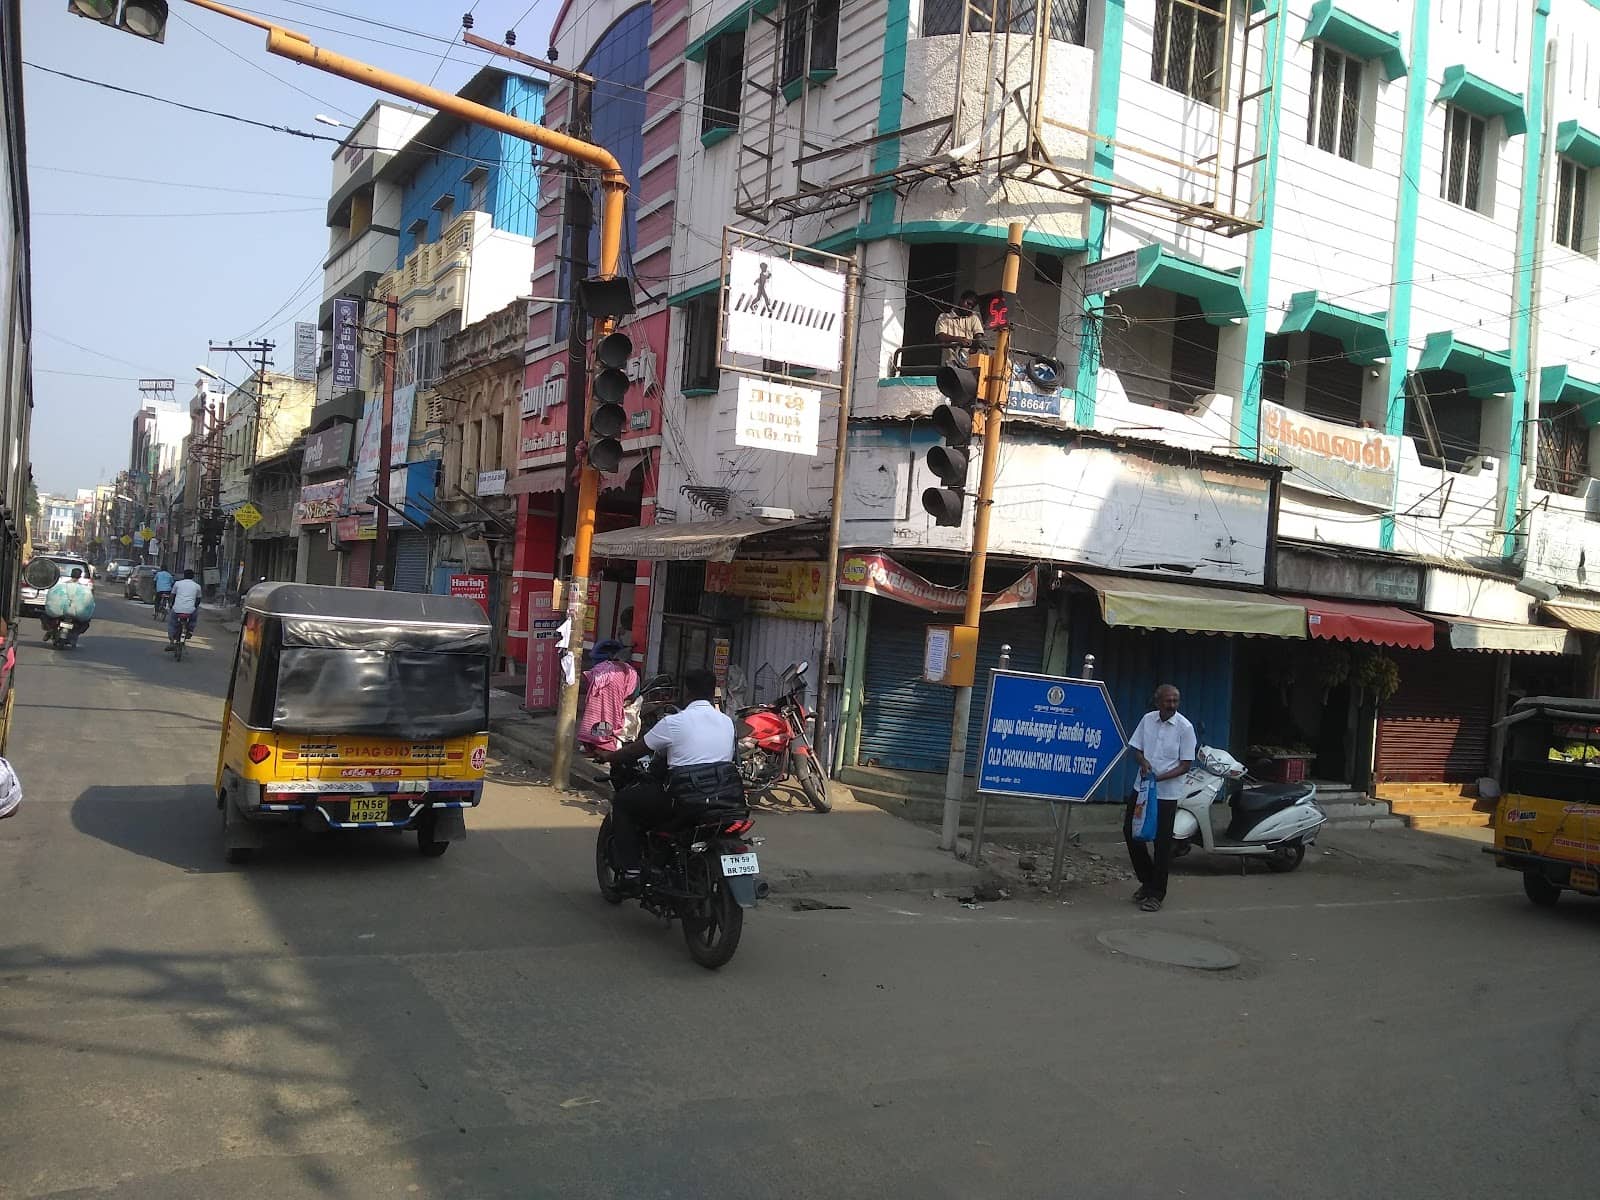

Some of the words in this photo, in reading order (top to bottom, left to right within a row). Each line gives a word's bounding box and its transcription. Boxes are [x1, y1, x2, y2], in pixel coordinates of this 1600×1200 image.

[1020, 397, 1052, 411] 86647
[452, 577, 486, 590] Harish
[992, 718, 1014, 740] பழைய
[1015, 717, 1057, 743] சொக்கநாதர்
[1057, 721, 1084, 742] கோவில்
[1084, 727, 1102, 749] தெரு
[988, 747, 1001, 766] OLD
[1002, 749, 1053, 771] CHOKKANATHAR
[1053, 754, 1072, 773] KOVIL
[1072, 756, 1098, 776] STREET
[739, 865, 756, 874] 7950
